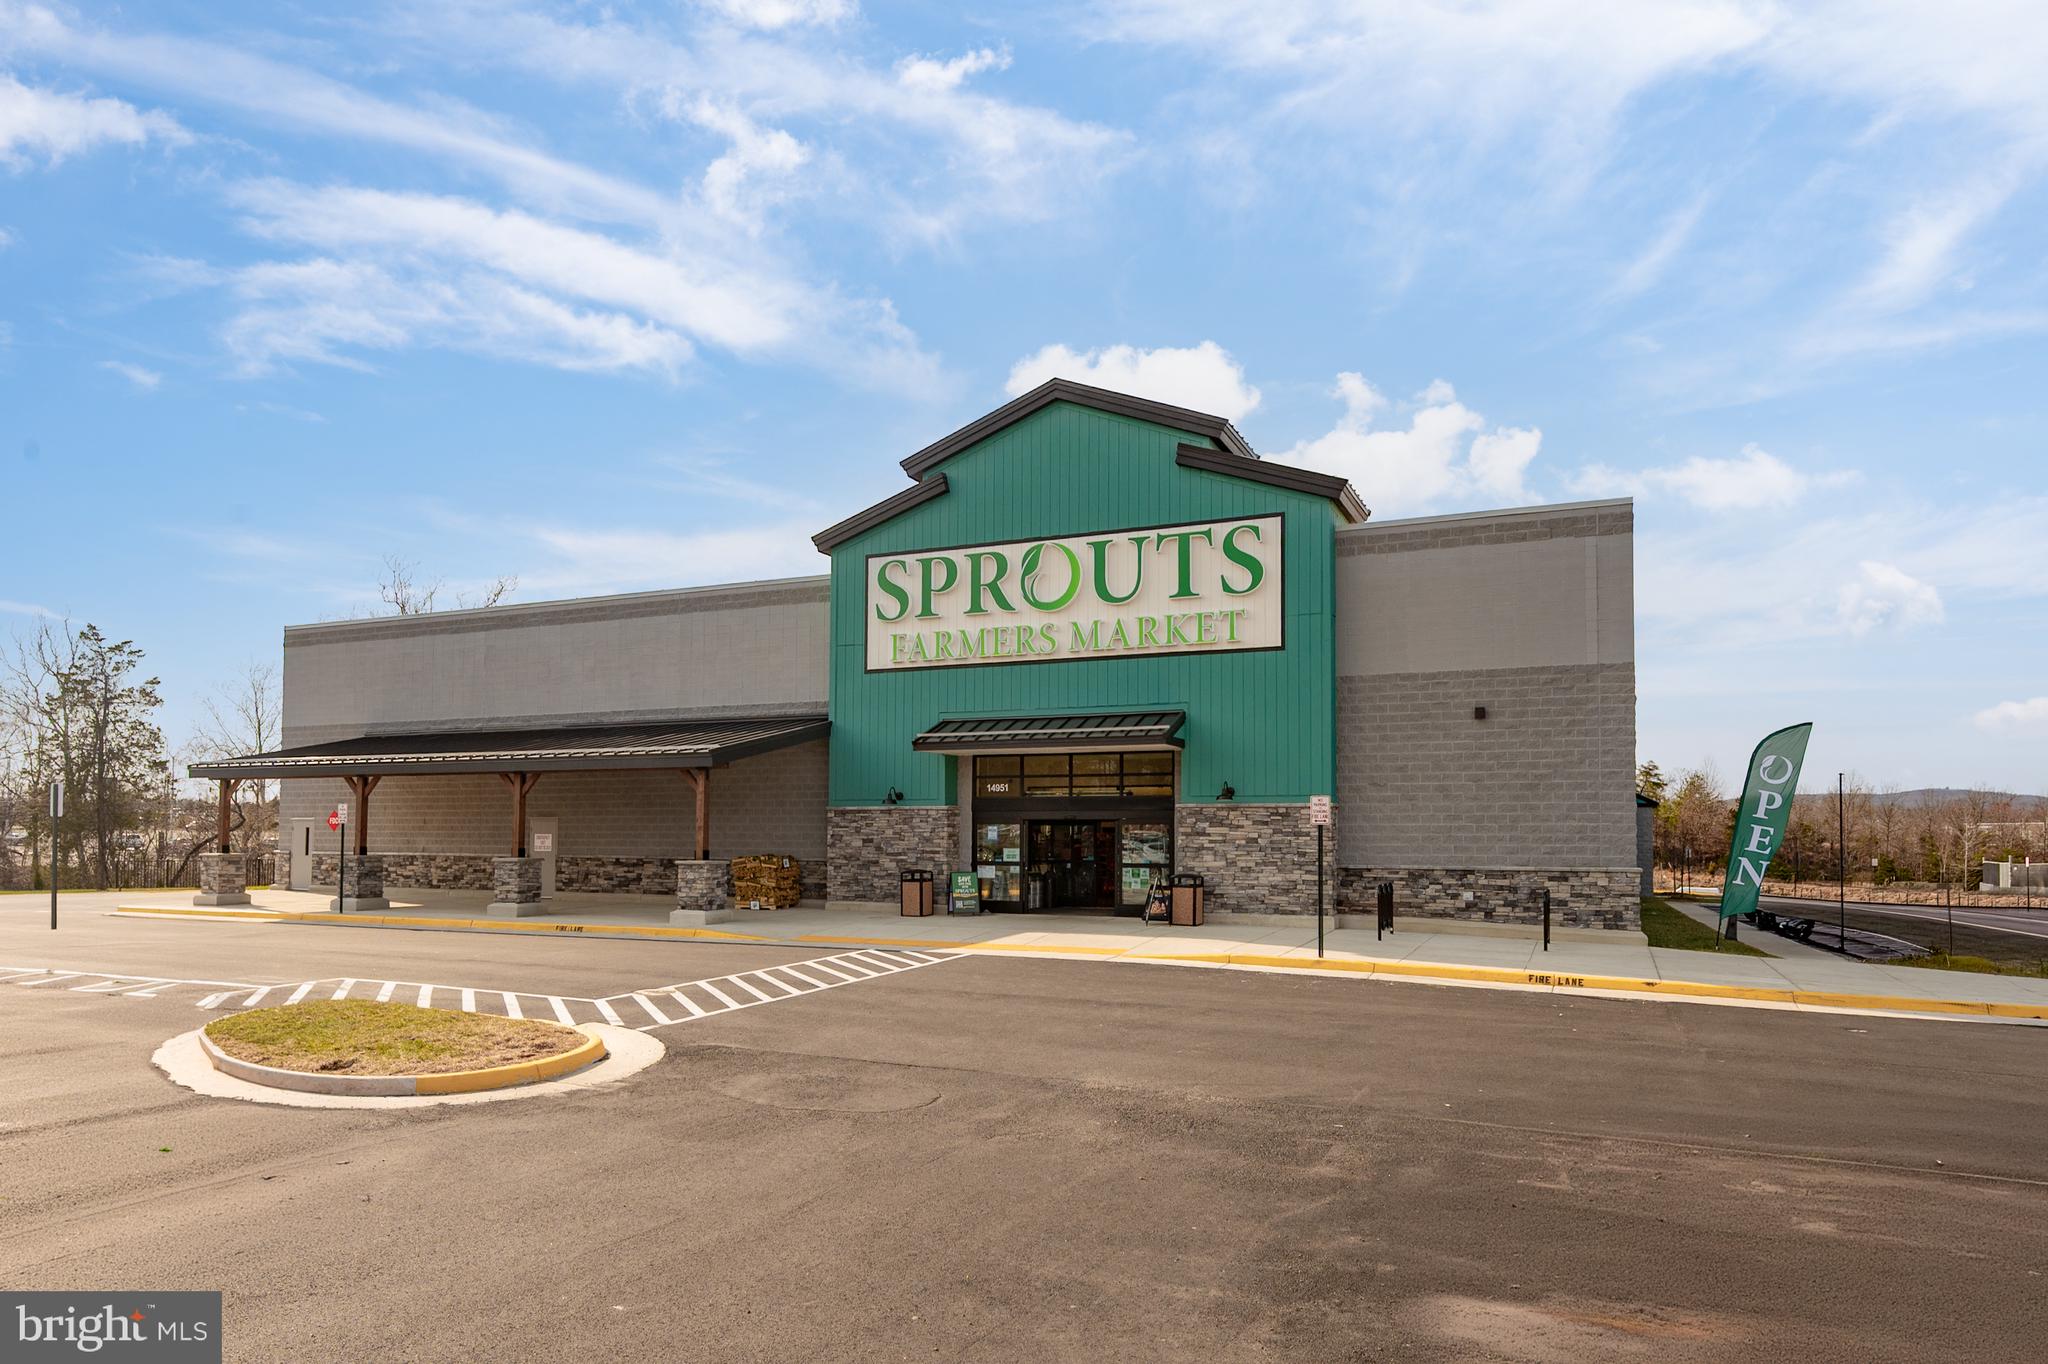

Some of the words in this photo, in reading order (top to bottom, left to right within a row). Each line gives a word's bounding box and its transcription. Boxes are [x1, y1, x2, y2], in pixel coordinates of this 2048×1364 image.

[875, 524, 1265, 623] SPROUTS
[890, 622, 1058, 664] FARMERS
[1068, 608, 1247, 652] MARKET
[986, 783, 1009, 793] 14951
[1732, 754, 1794, 889] OPEN
[1528, 974, 1551, 984] FIRE
[1557, 976, 1585, 987] LANE
